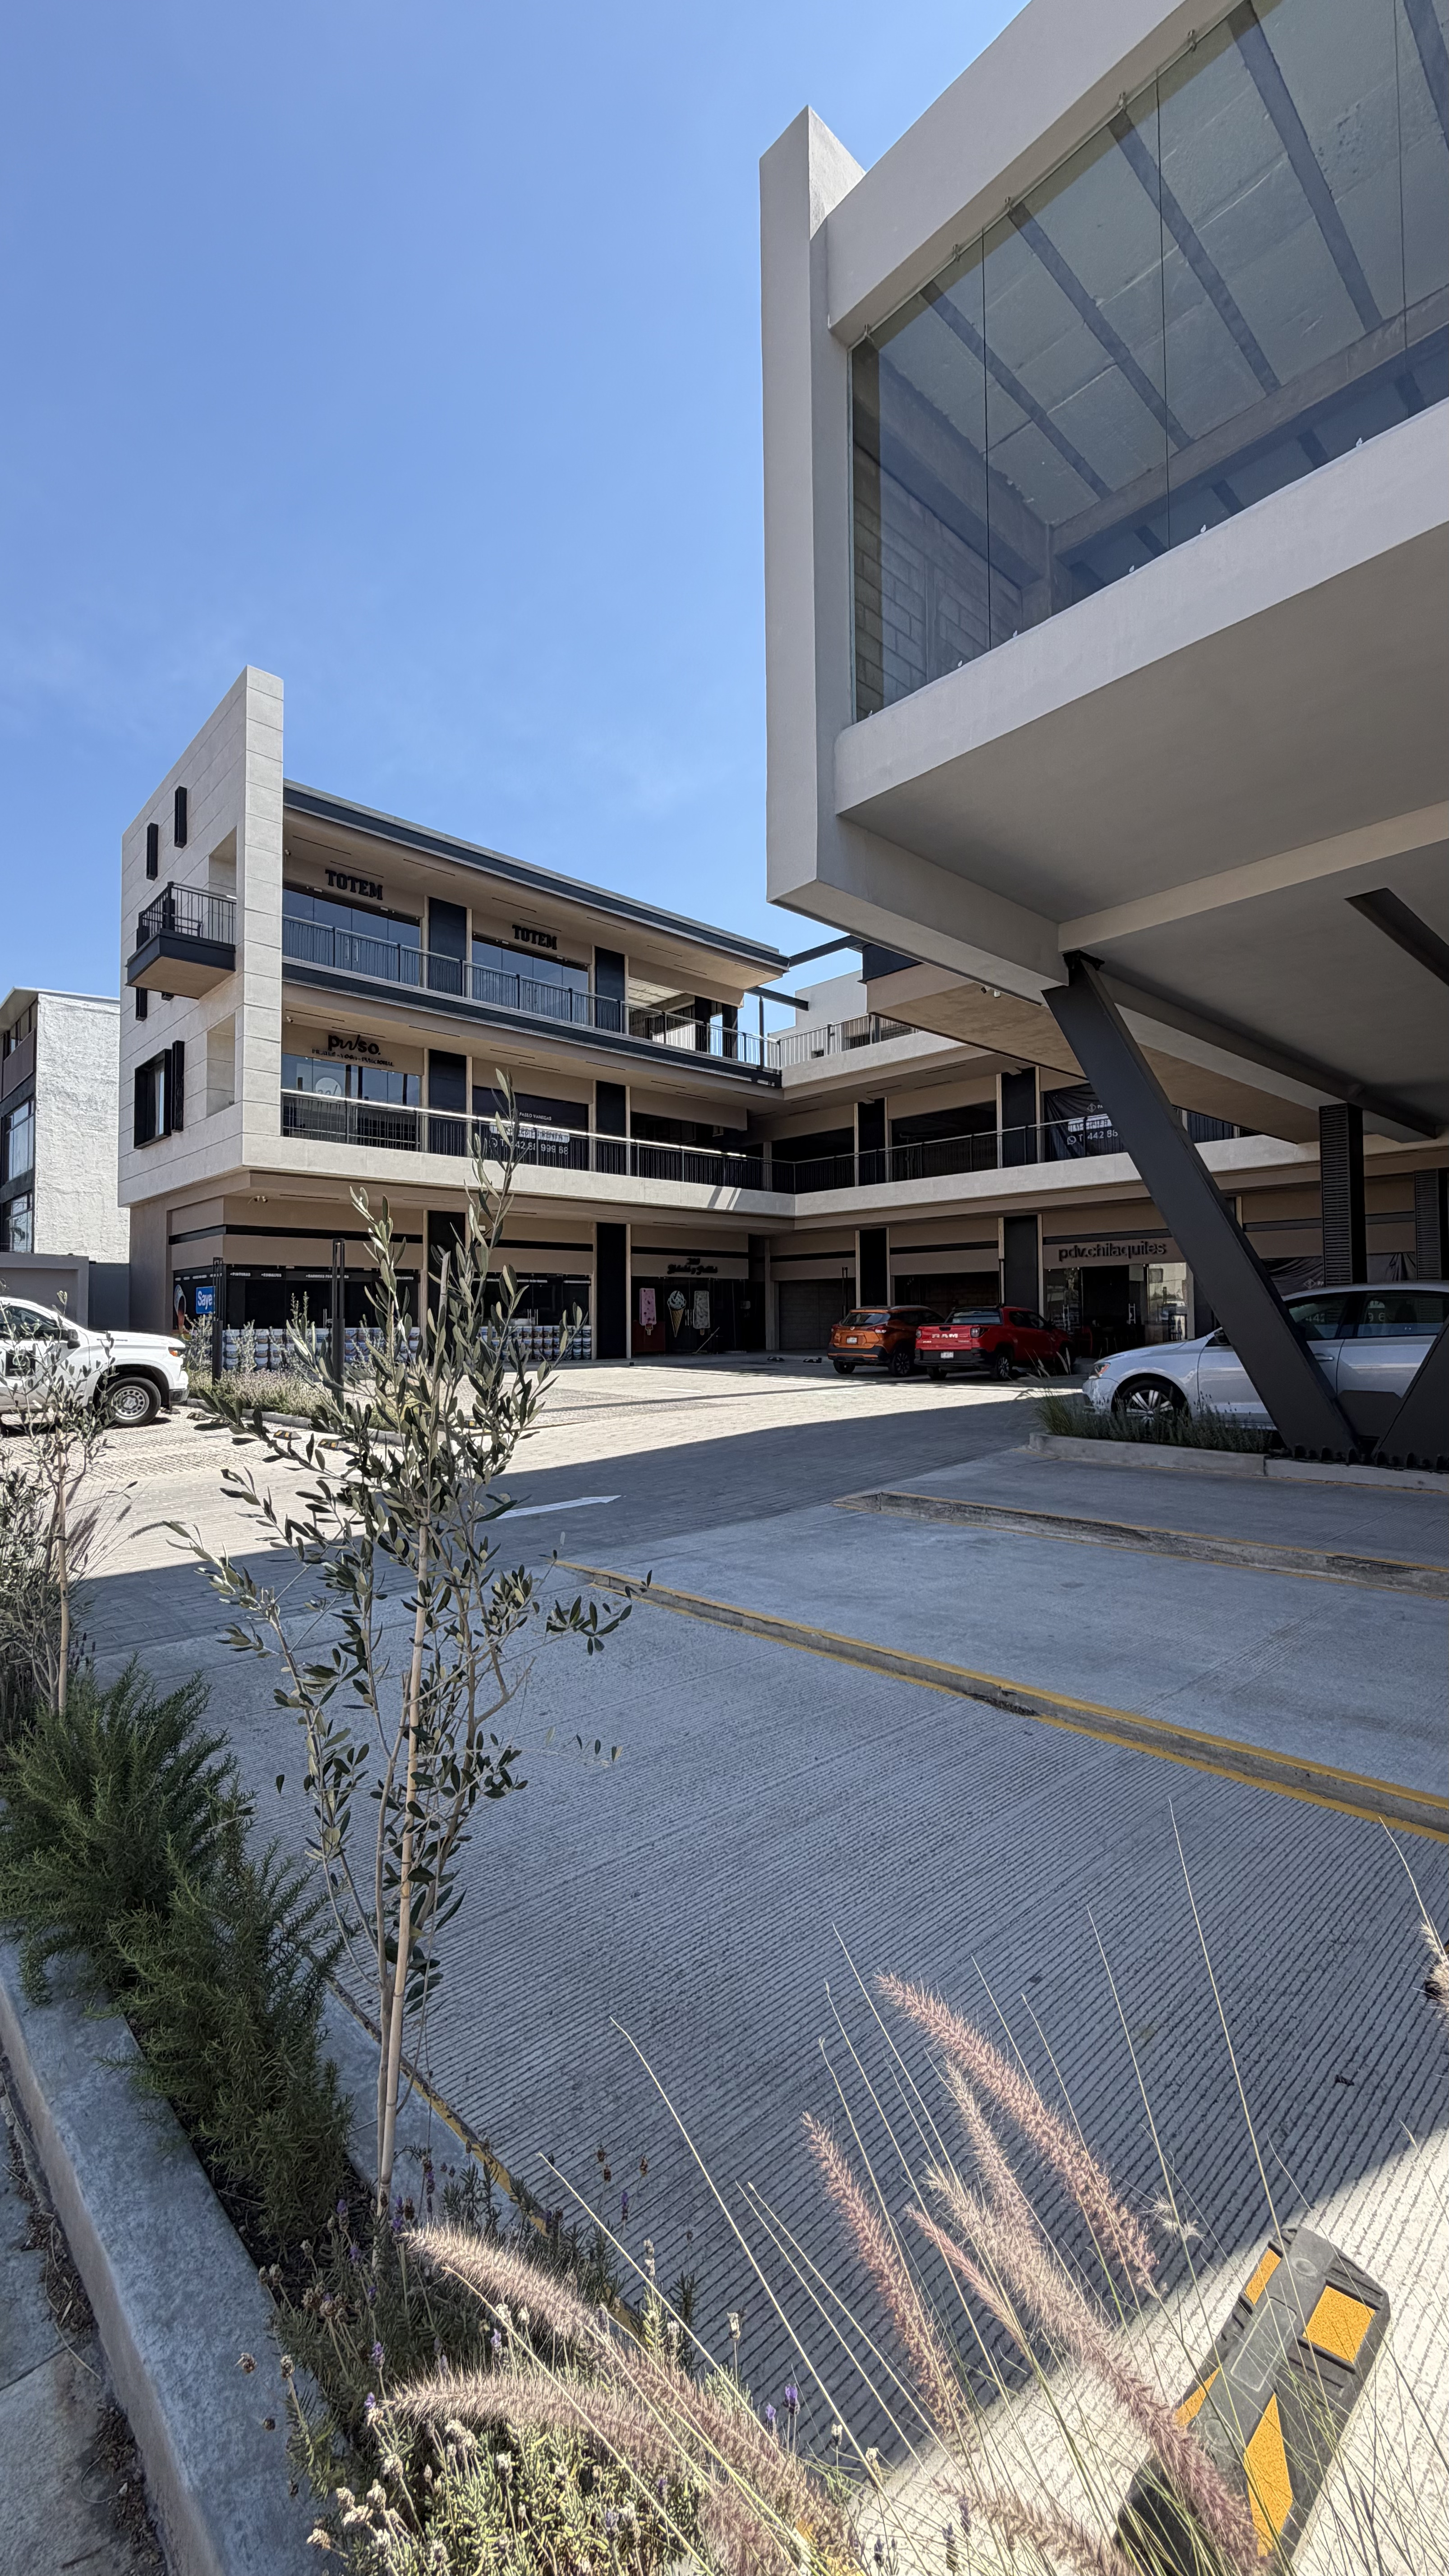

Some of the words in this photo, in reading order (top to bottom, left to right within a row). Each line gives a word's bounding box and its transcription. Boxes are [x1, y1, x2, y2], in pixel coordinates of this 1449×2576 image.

[325, 869, 382, 900] TOTEM
[512, 925, 557, 950] TOTEM
[1087, 1131, 1104, 1140] 442
[511, 1140, 526, 1149] 42
[541, 1144, 556, 1153] 999
[1058, 1241, 1167, 1261] pdv.chilaquiles
[198, 1290, 214, 1310] Saye
